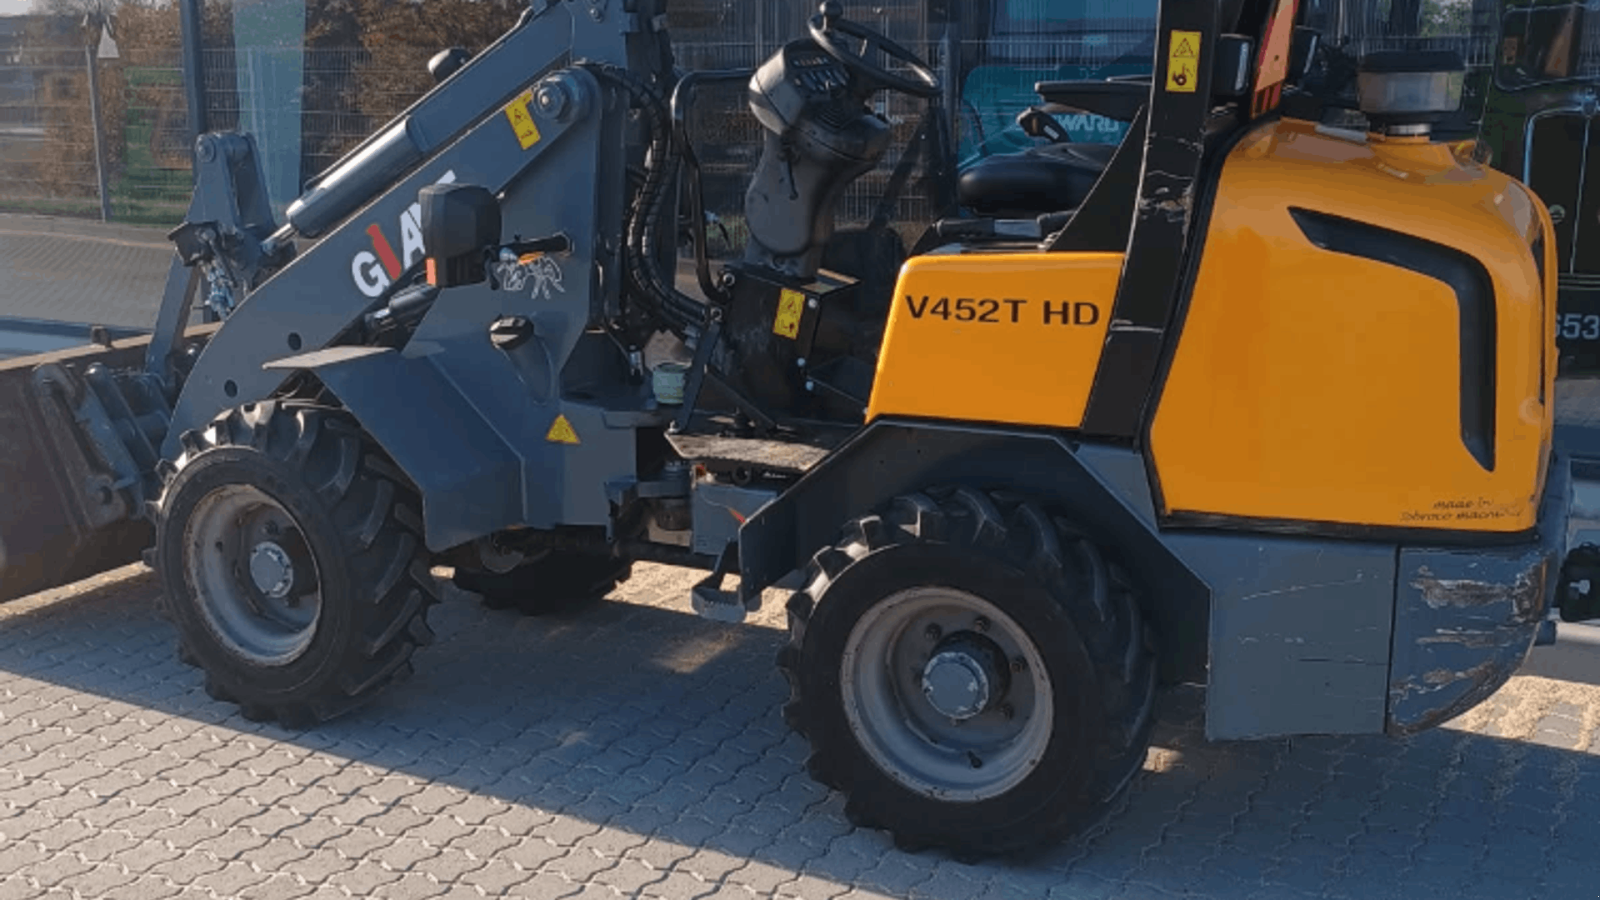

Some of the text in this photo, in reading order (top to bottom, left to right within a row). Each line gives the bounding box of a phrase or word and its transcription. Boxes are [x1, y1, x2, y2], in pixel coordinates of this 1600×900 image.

[1052, 114, 1119, 132] WARD
[905, 295, 1100, 326] V452T HD
